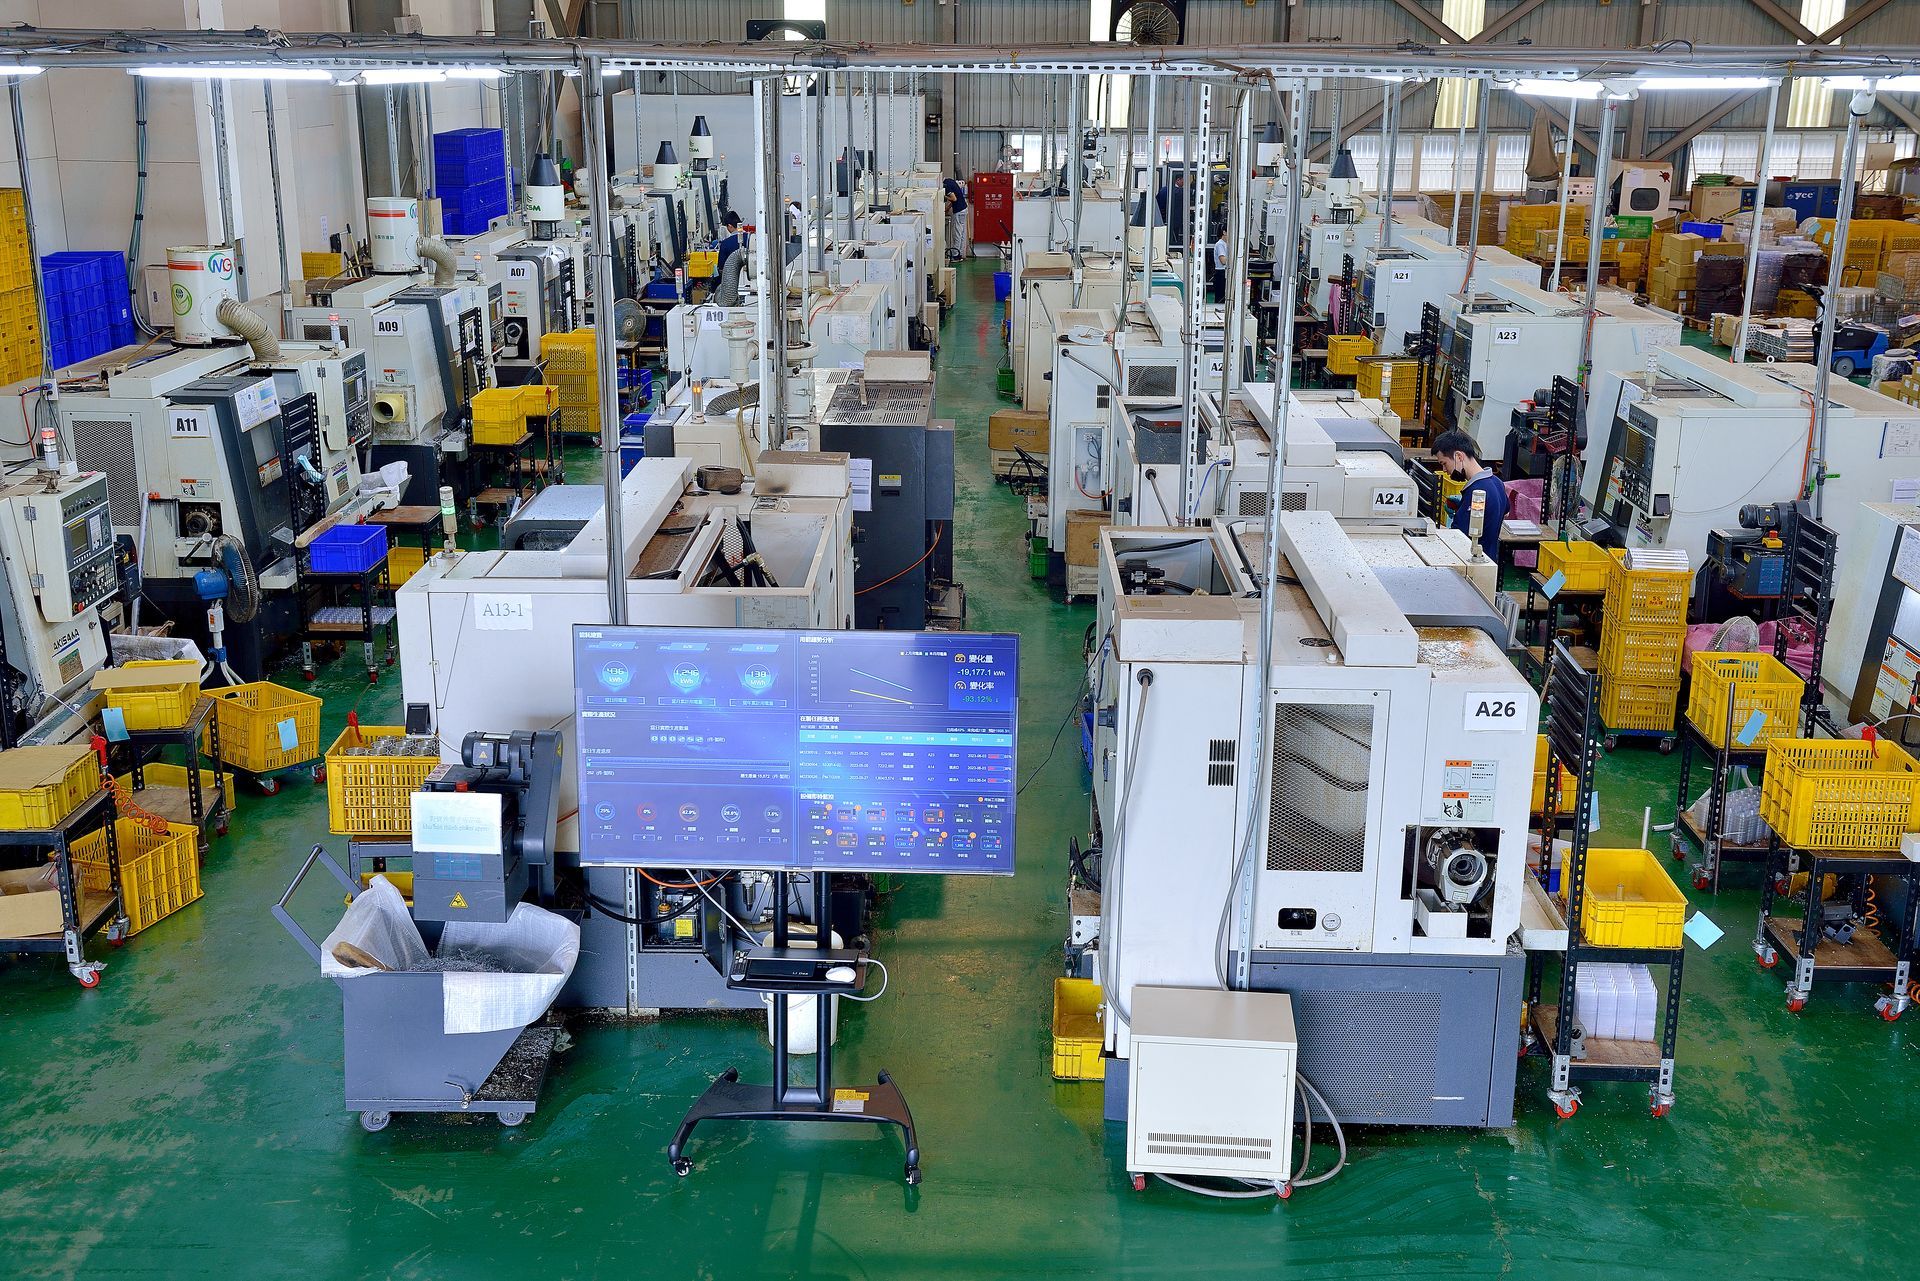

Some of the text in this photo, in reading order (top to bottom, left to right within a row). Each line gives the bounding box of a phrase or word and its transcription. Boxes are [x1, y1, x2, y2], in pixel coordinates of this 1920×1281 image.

[510, 267, 525, 277] A07
[1393, 272, 1409, 280] A21
[705, 310, 724, 322] A10
[378, 321, 399, 332] A09
[1496, 331, 1517, 341] A23
[176, 417, 198, 432] A11
[1375, 492, 1404, 505] A24
[482, 602, 524, 617] A13-1
[969, 654, 994, 663] 變化量
[957, 668, 991, 676] -19,177.1
[1475, 701, 1516, 718] A26
